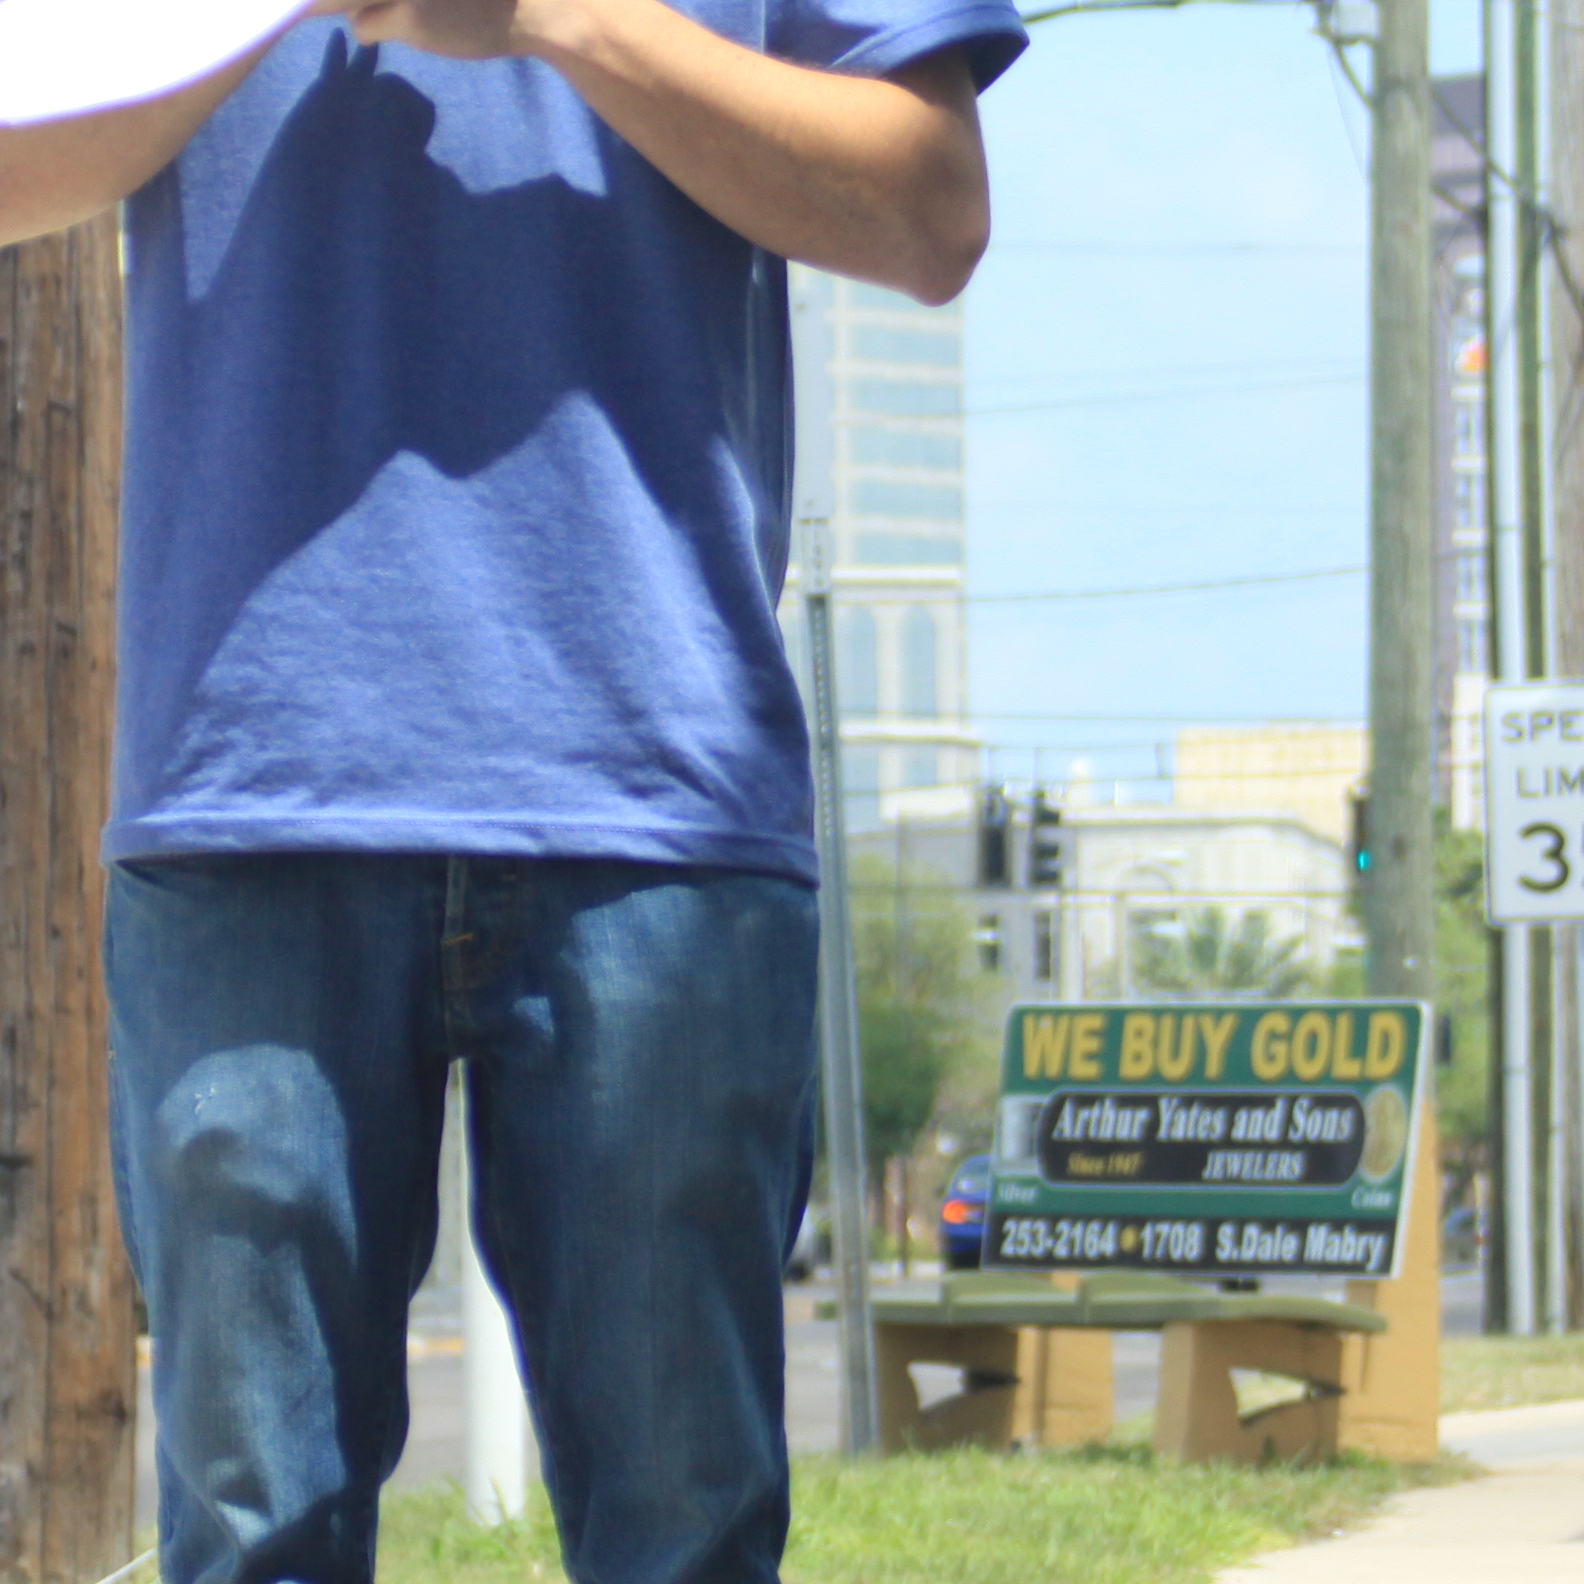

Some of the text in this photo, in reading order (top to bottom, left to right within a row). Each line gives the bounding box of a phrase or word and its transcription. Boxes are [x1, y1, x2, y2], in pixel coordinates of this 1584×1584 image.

[1022, 1009, 1408, 1082] WE BUY GOLD
[1050, 1096, 1354, 1143] Arthur Yates and Sons
[1202, 1150, 1307, 1181] JEWELERS
[999, 1219, 1116, 1259] 253-2164
[1138, 1222, 1205, 1262] 1708
[1305, 1222, 1388, 1273] Mabry
